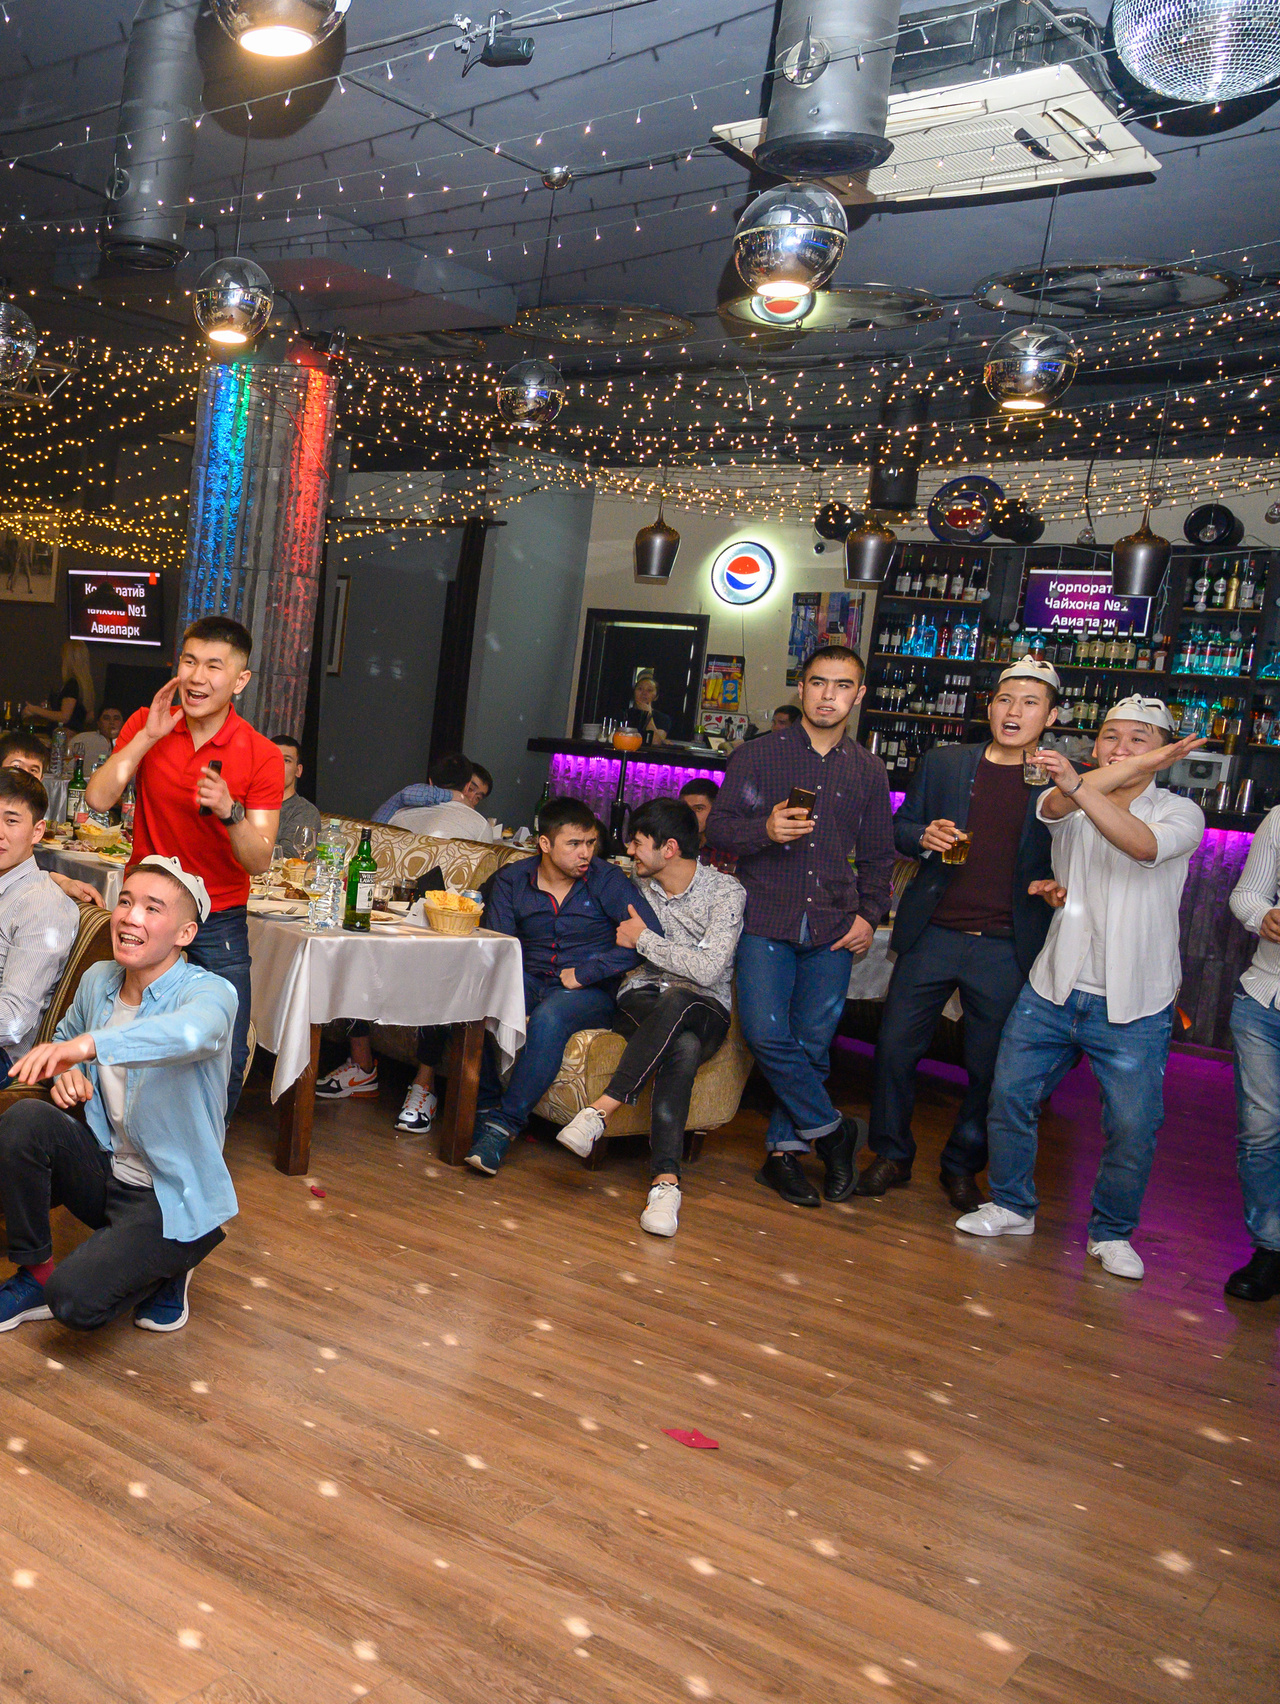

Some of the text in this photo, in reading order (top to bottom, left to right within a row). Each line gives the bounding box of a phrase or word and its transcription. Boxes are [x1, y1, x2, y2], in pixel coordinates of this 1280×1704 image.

[84, 583, 146, 598] Коратив
[1049, 581, 1113, 595] Корпорат
[127, 604, 147, 617] №1
[1044, 597, 1100, 610] Чайхона
[90, 621, 140, 638] Авиапарк
